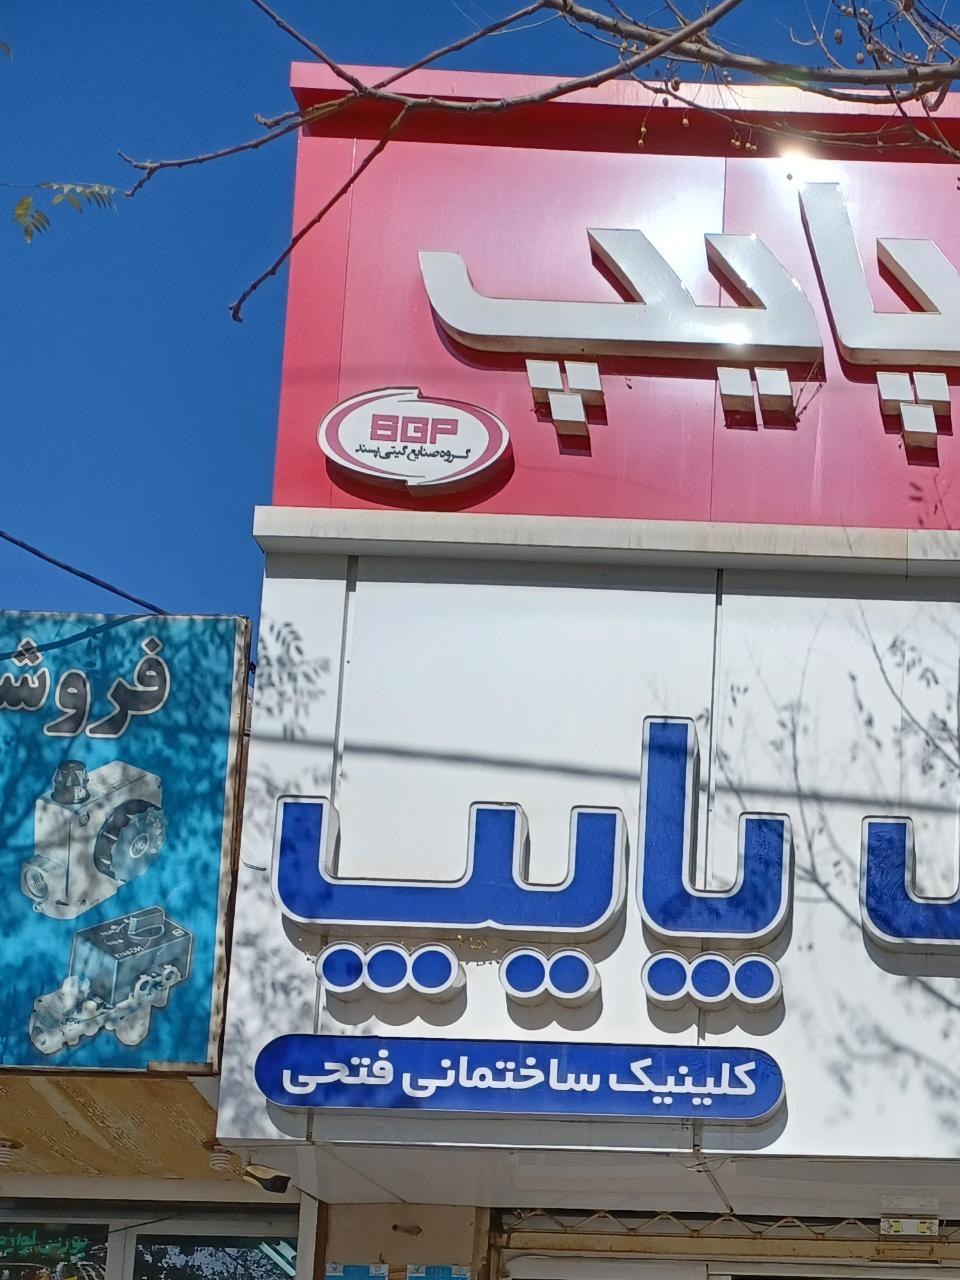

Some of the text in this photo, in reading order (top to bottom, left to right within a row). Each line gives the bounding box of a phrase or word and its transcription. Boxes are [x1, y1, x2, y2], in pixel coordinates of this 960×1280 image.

[370, 413, 459, 445] SGP
[379, 444, 408, 459] گیتی
[406, 445, 440, 461] صنایع
[439, 447, 471, 463] گروه
[272, 718, 792, 1003] پایپ
[281, 1049, 756, 1106] کلینیک ساختمانی فتحی
